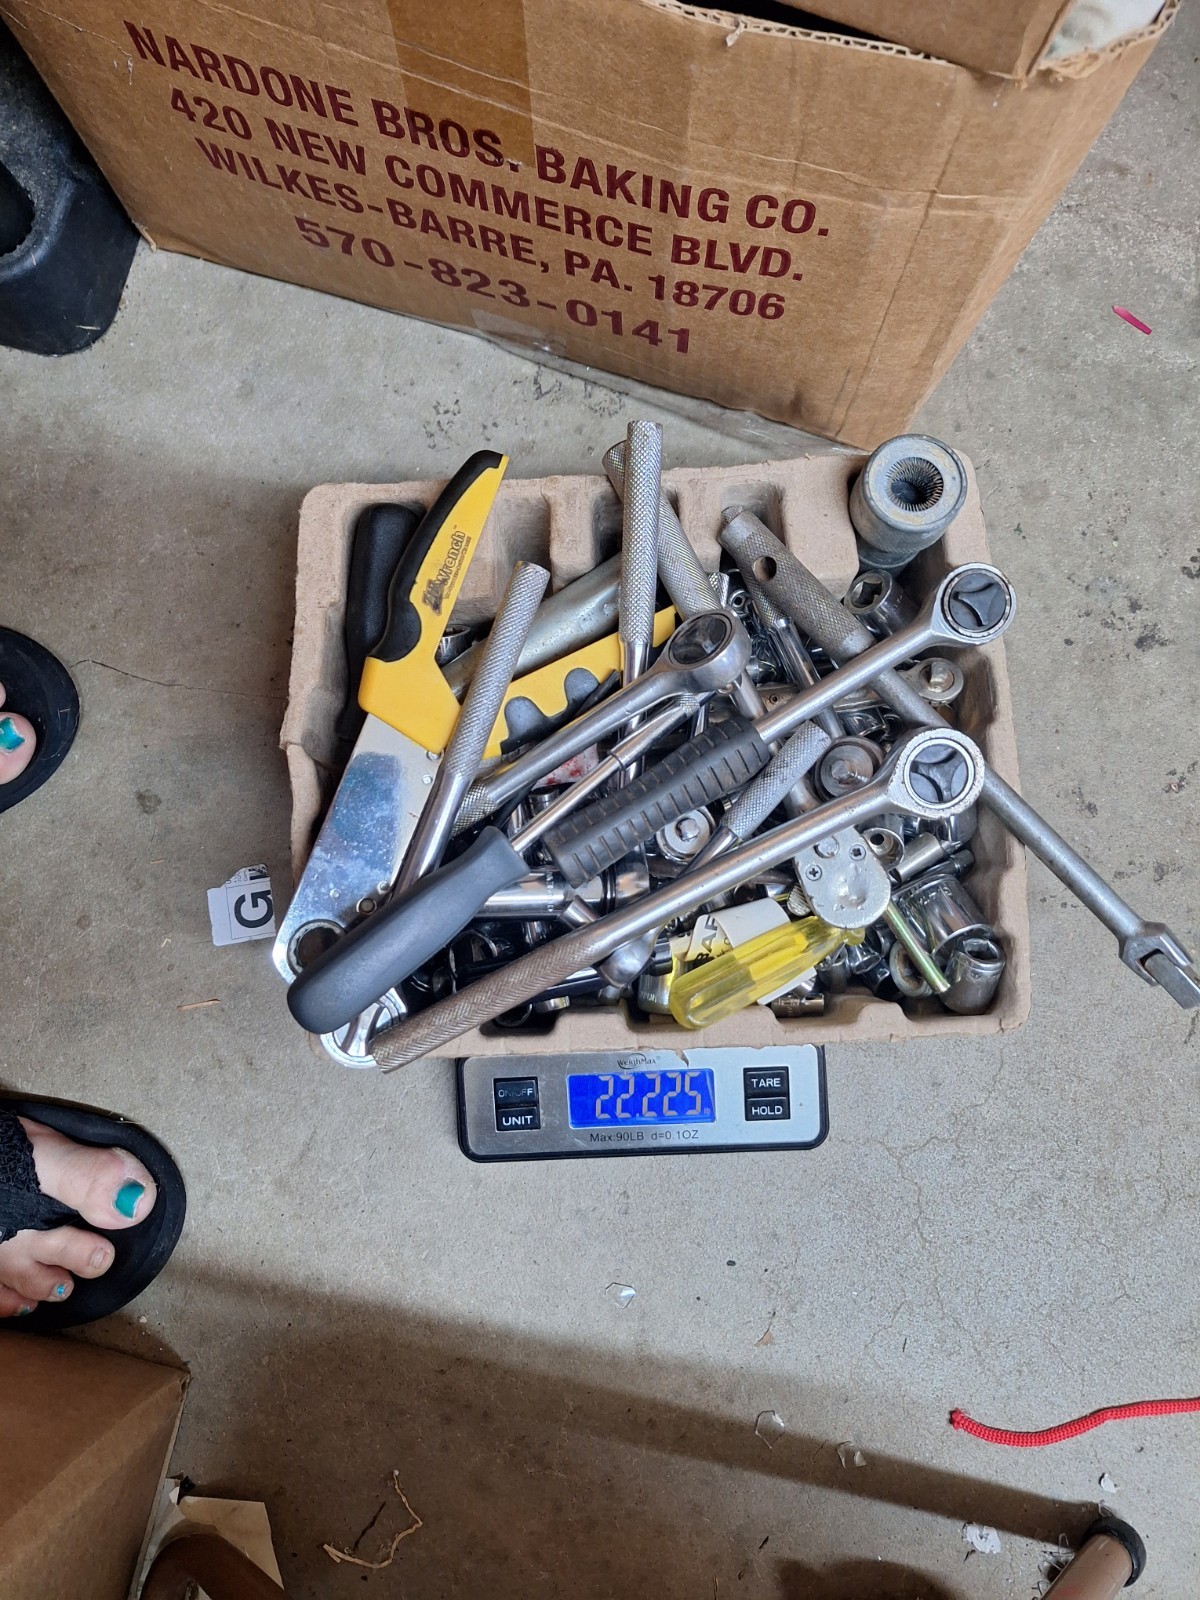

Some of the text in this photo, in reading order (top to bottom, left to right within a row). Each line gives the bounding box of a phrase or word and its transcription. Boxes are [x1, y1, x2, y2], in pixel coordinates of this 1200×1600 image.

[123, 20, 829, 237] NARDONE BROS. BAKING CO.
[171, 87, 803, 281] 420 NEW COMMERCE BLVD.
[194, 136, 785, 320] WILKES-BARRE, PA. 18706
[294, 215, 690, 354] 570-823-0141
[233, 889, 274, 929] G
[502, 1115, 534, 1126] UNIT
[750, 1077, 782, 1088] TARE
[751, 1105, 783, 1116] HOLD
